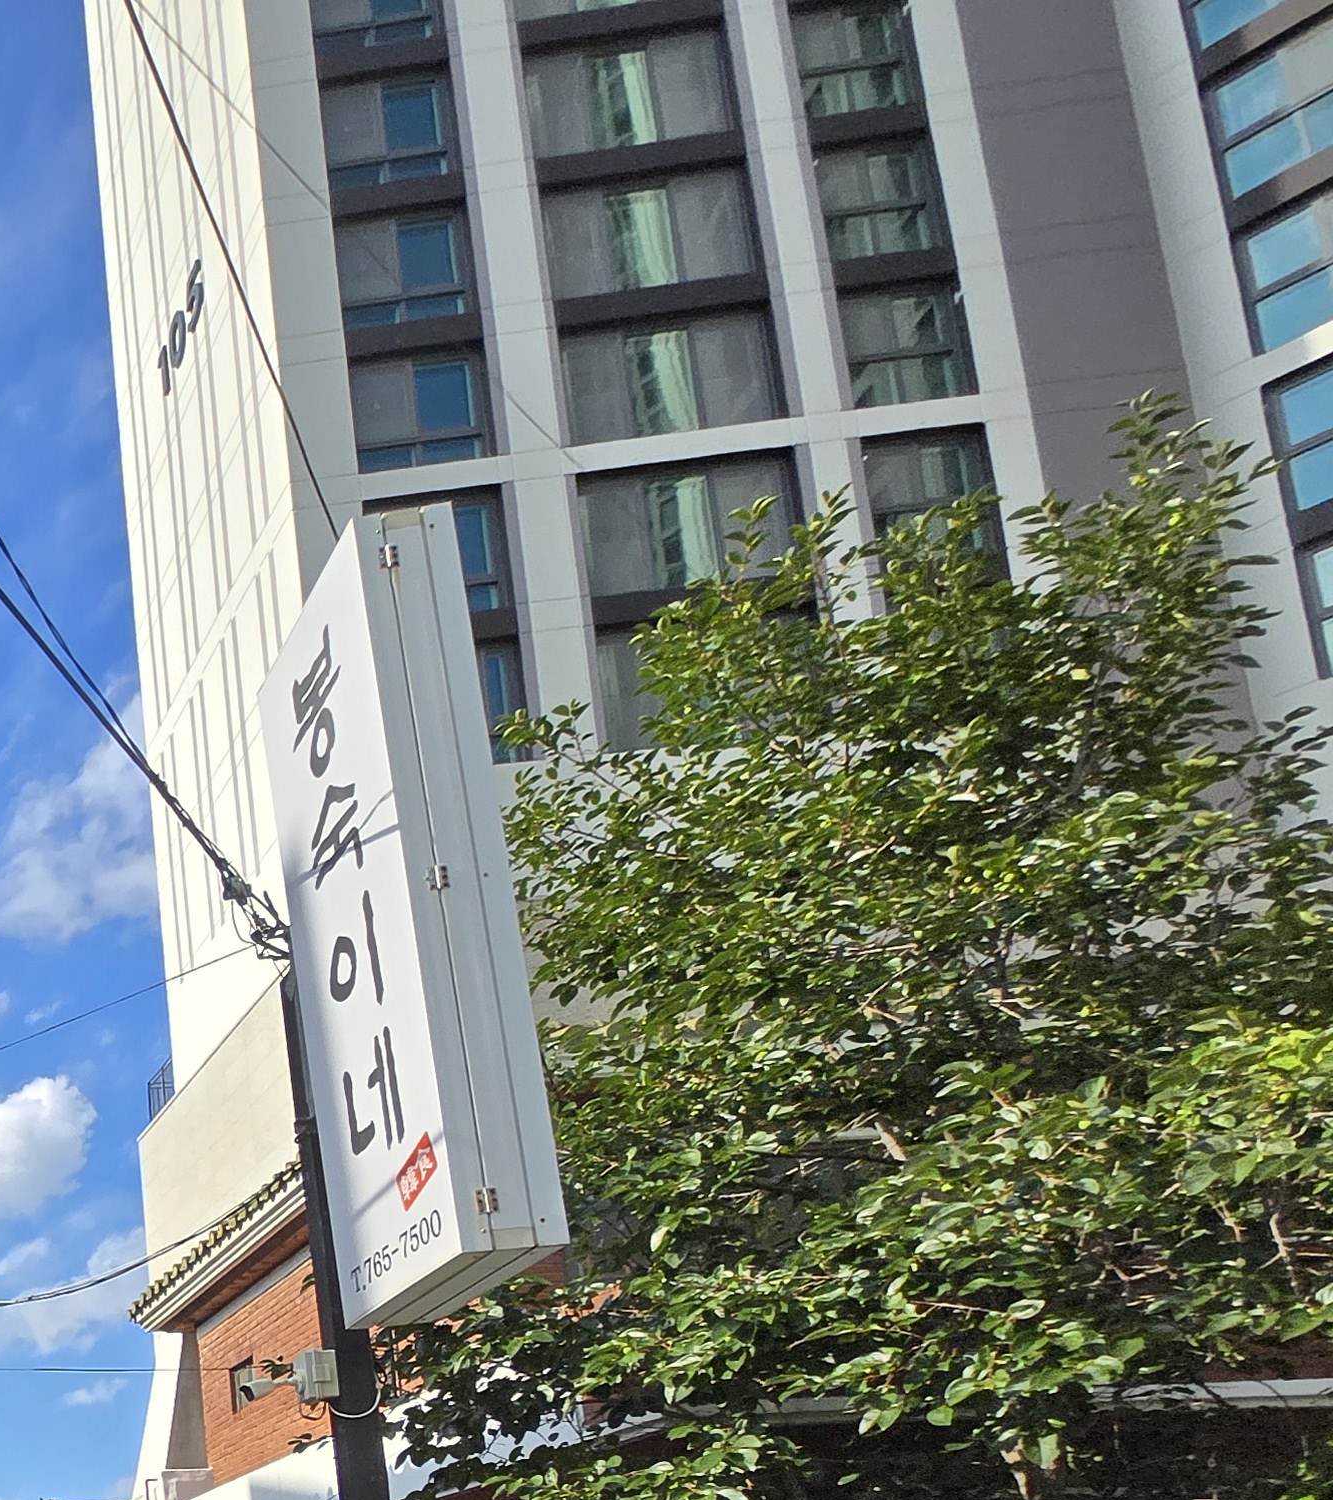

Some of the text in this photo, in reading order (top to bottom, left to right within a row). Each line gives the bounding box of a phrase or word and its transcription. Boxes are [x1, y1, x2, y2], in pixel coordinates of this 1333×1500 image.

[157, 258, 204, 397] 105
[292, 623, 405, 1156] 봉숙이네
[351, 1209, 442, 1293] T.765-7500
